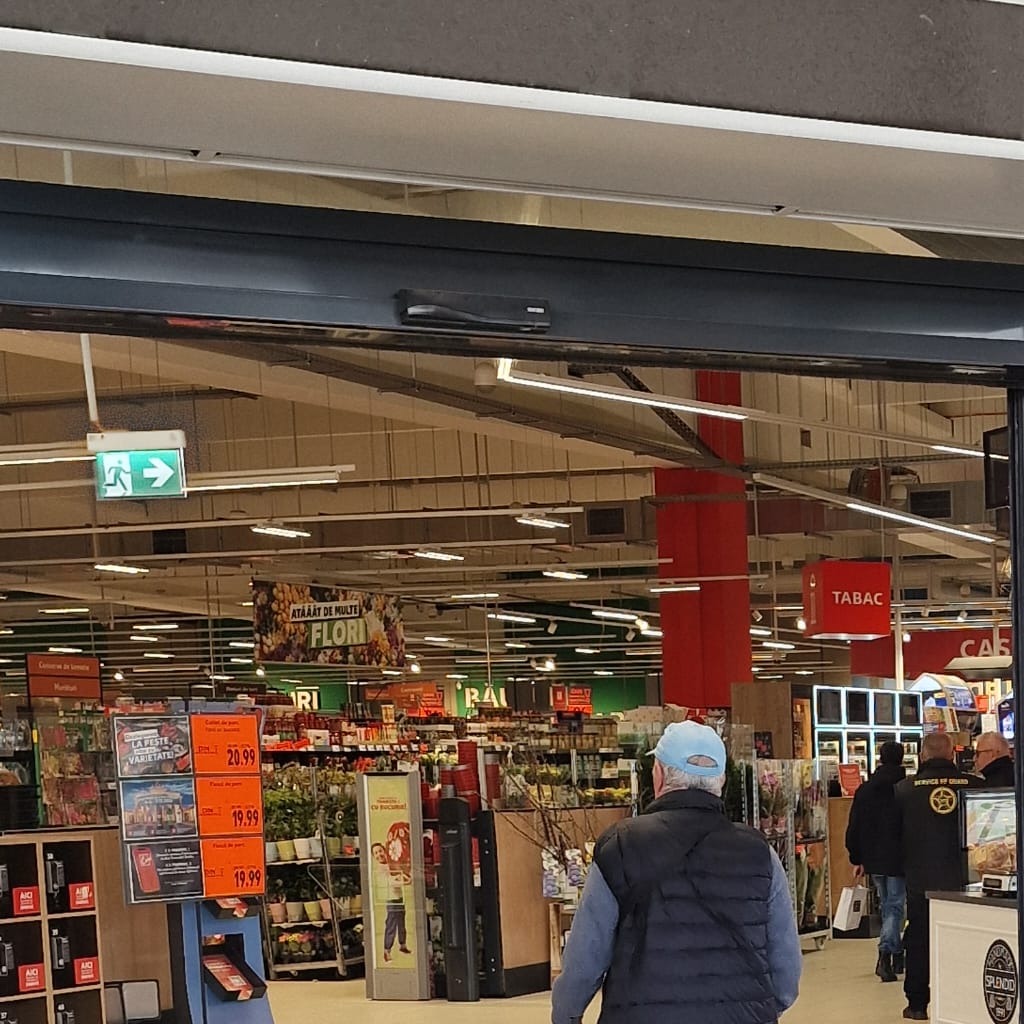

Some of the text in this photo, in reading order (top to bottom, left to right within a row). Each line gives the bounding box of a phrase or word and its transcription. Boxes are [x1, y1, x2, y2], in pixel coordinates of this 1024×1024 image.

[832, 591, 884, 606] TABAC
[324, 606, 334, 617] DE
[335, 604, 358, 616] MULTE
[311, 619, 366, 648] FLORI
[227, 748, 256, 766] 20.99
[232, 809, 259, 827] 19.99
[234, 869, 261, 888] 19.99
